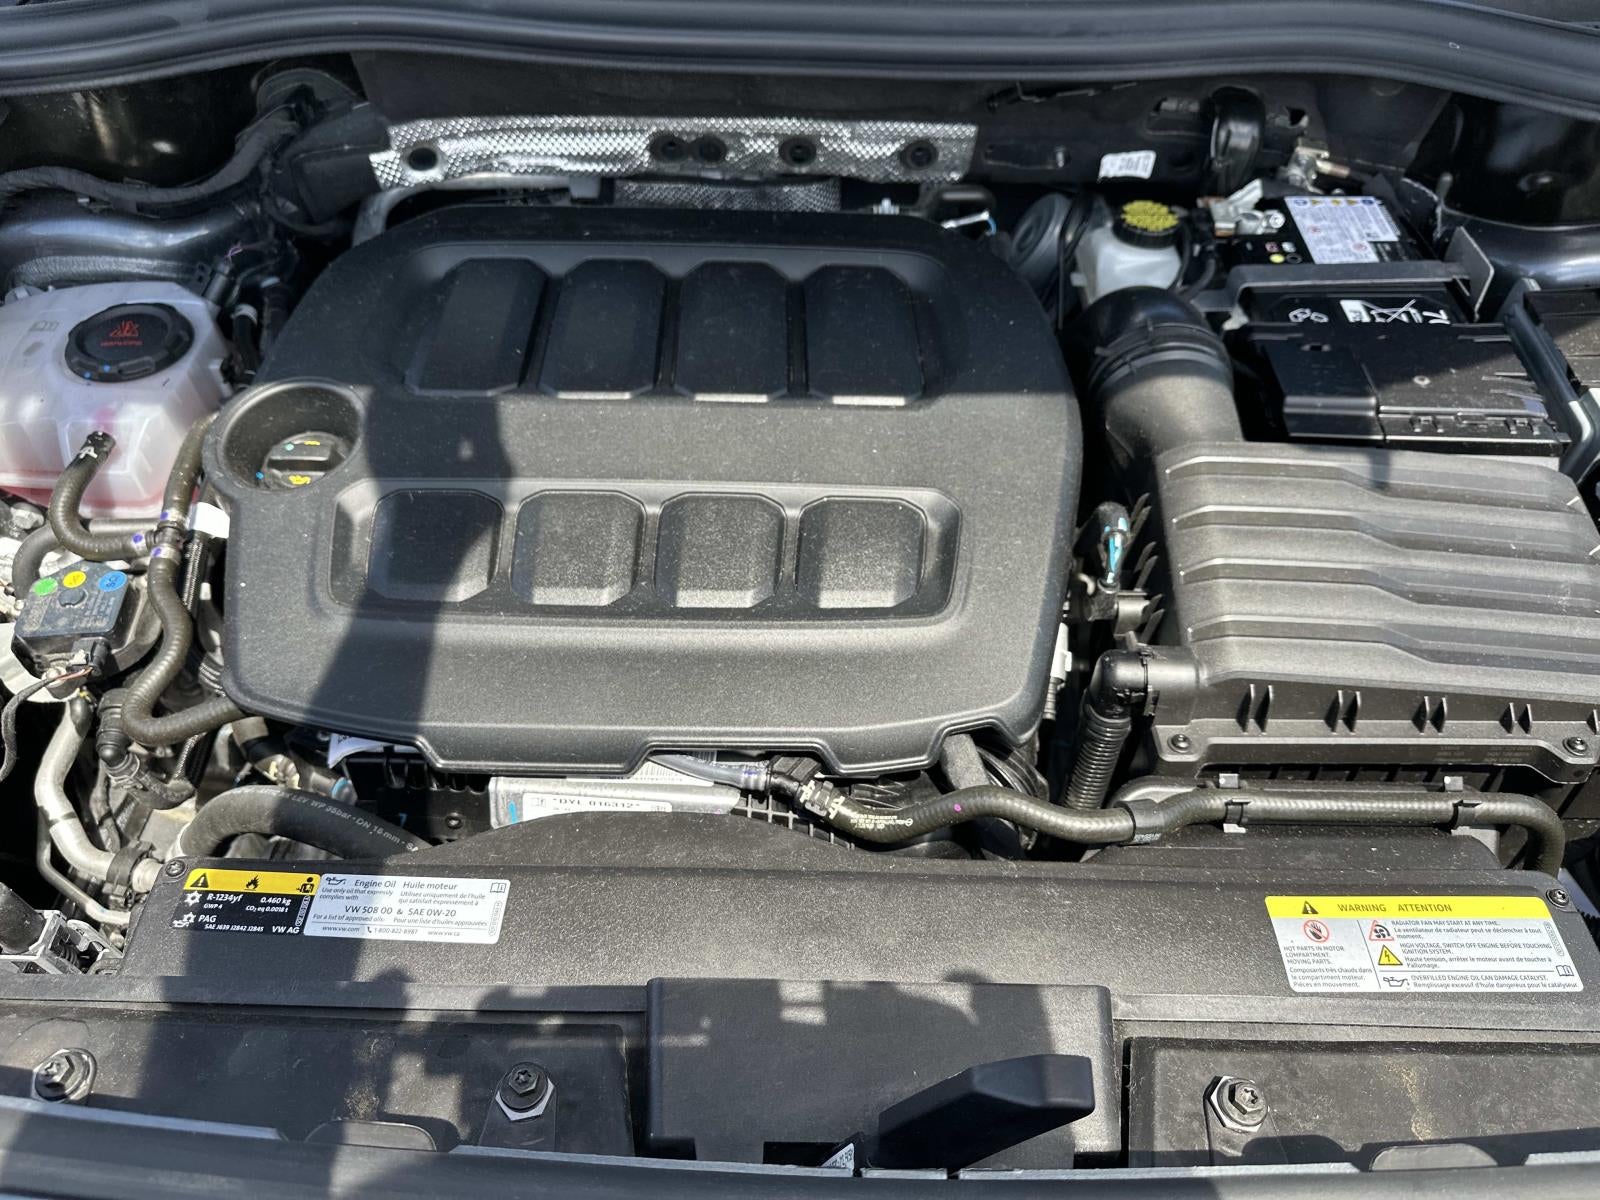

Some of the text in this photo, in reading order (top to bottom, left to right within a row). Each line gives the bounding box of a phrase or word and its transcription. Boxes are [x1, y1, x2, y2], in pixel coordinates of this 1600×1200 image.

[326, 805, 352, 820] 35bar
[356, 818, 372, 829] DN
[384, 830, 400, 843] mm
[354, 880, 382, 888] Engine
[206, 893, 243, 904] R-1234yf
[282, 898, 291, 906] kg
[345, 905, 360, 913] VW
[380, 907, 393, 915] 00
[426, 909, 456, 917] 0W-20
[1337, 904, 1452, 912] WARNING ATTENTION
[198, 914, 216, 923] PAG
